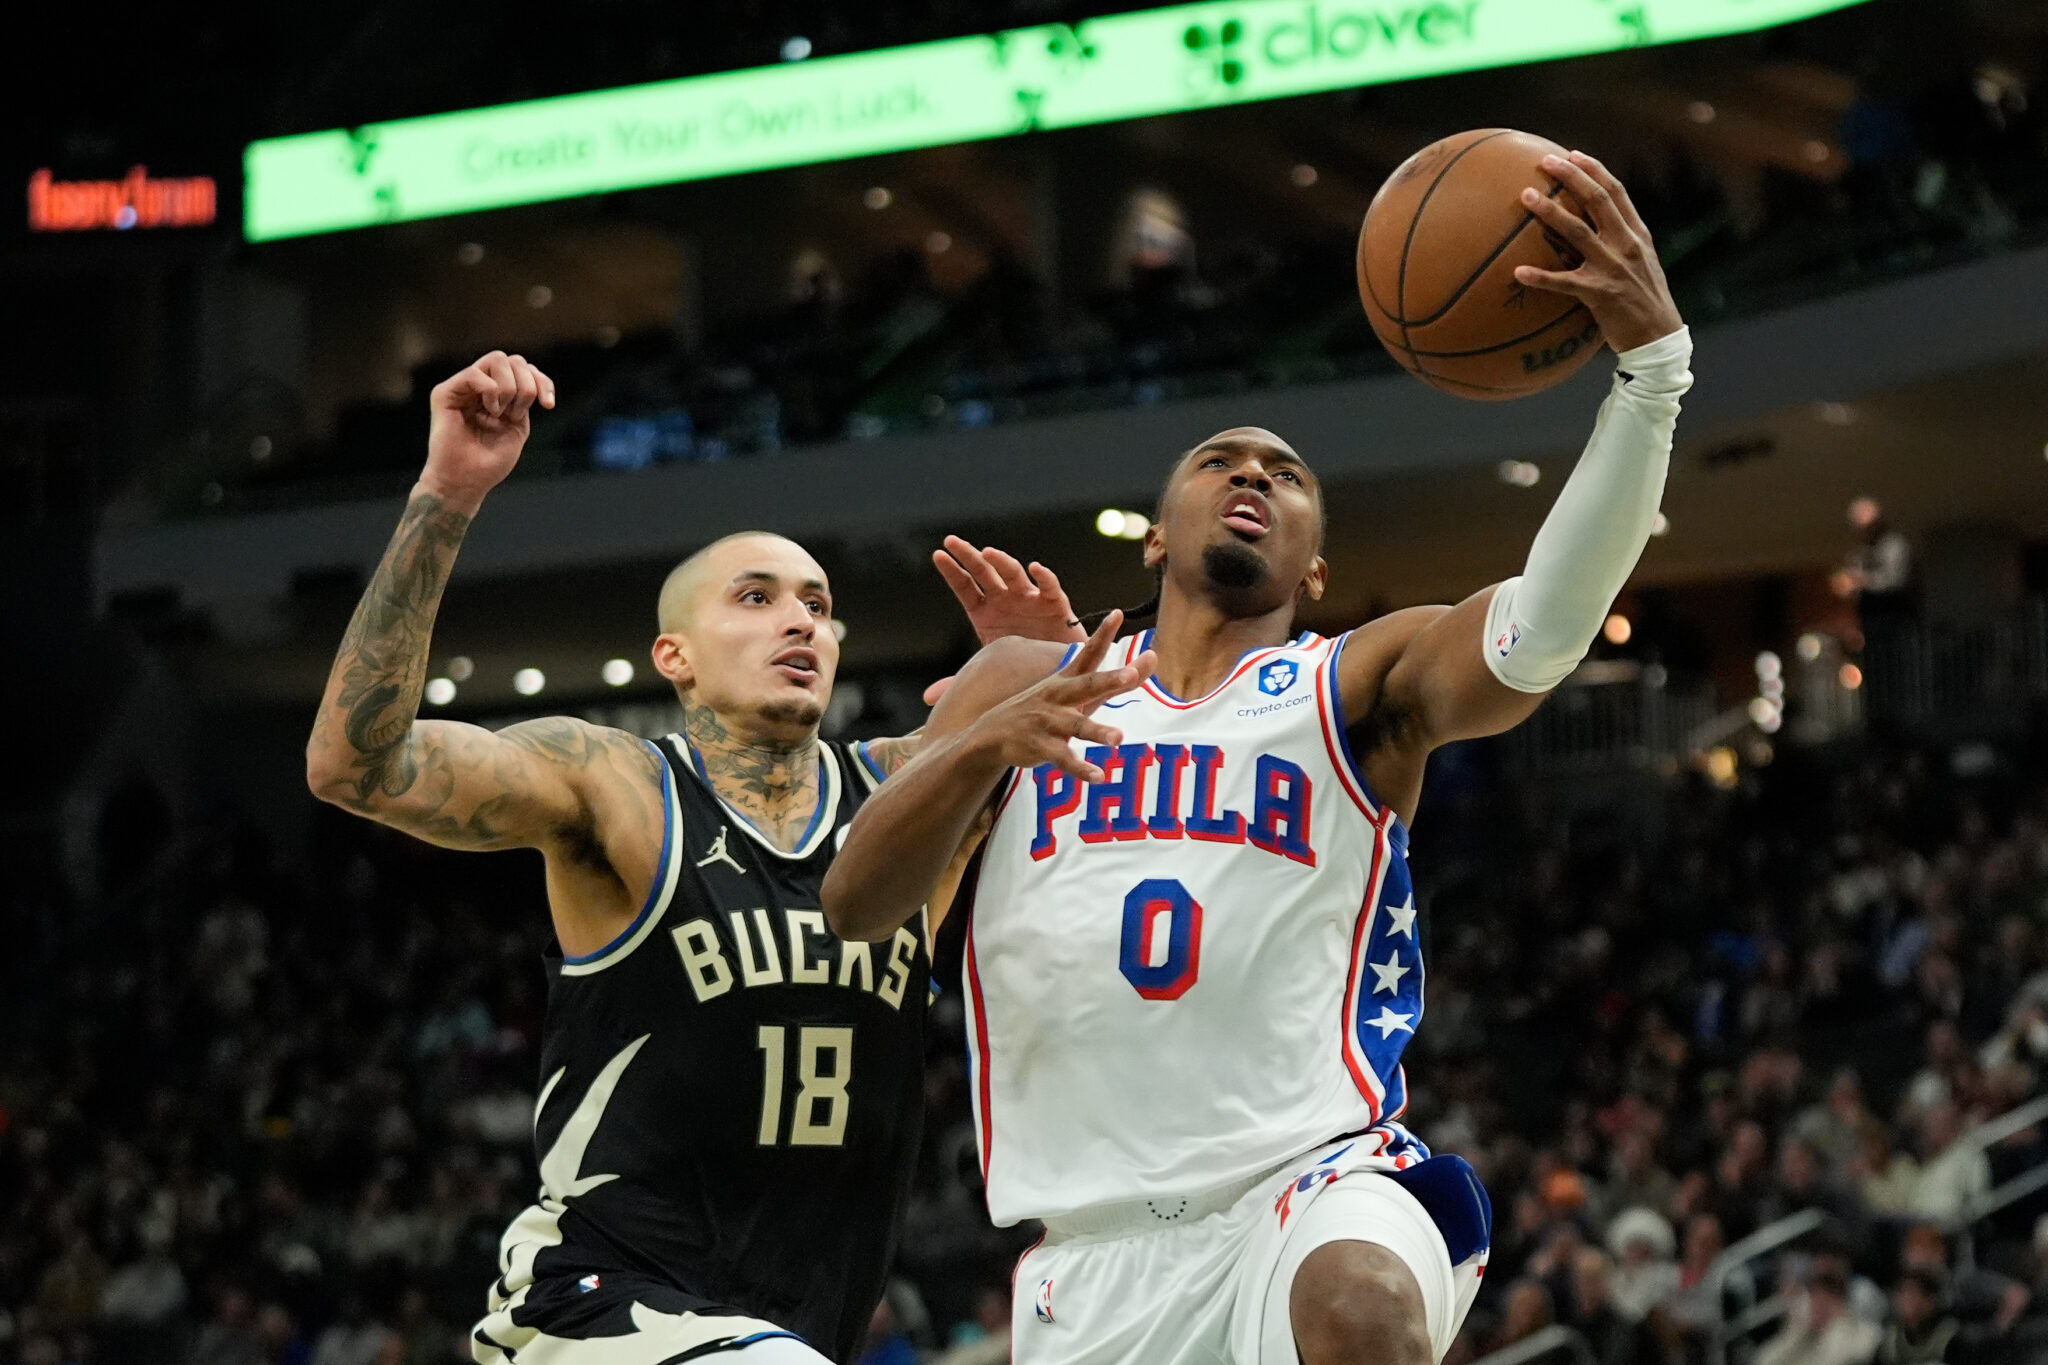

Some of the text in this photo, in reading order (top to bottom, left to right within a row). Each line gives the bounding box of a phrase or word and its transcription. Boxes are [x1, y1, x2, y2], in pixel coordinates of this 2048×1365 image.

[1264, 0, 1481, 66] clover
[461, 133, 596, 182] Create
[613, 117, 702, 155] Your
[717, 97, 818, 147] Own
[1237, 694, 1312, 717] crypto.com
[1030, 743, 1316, 868] PHILA
[1119, 879, 1203, 1001] 0
[758, 1025, 853, 1146] 18
